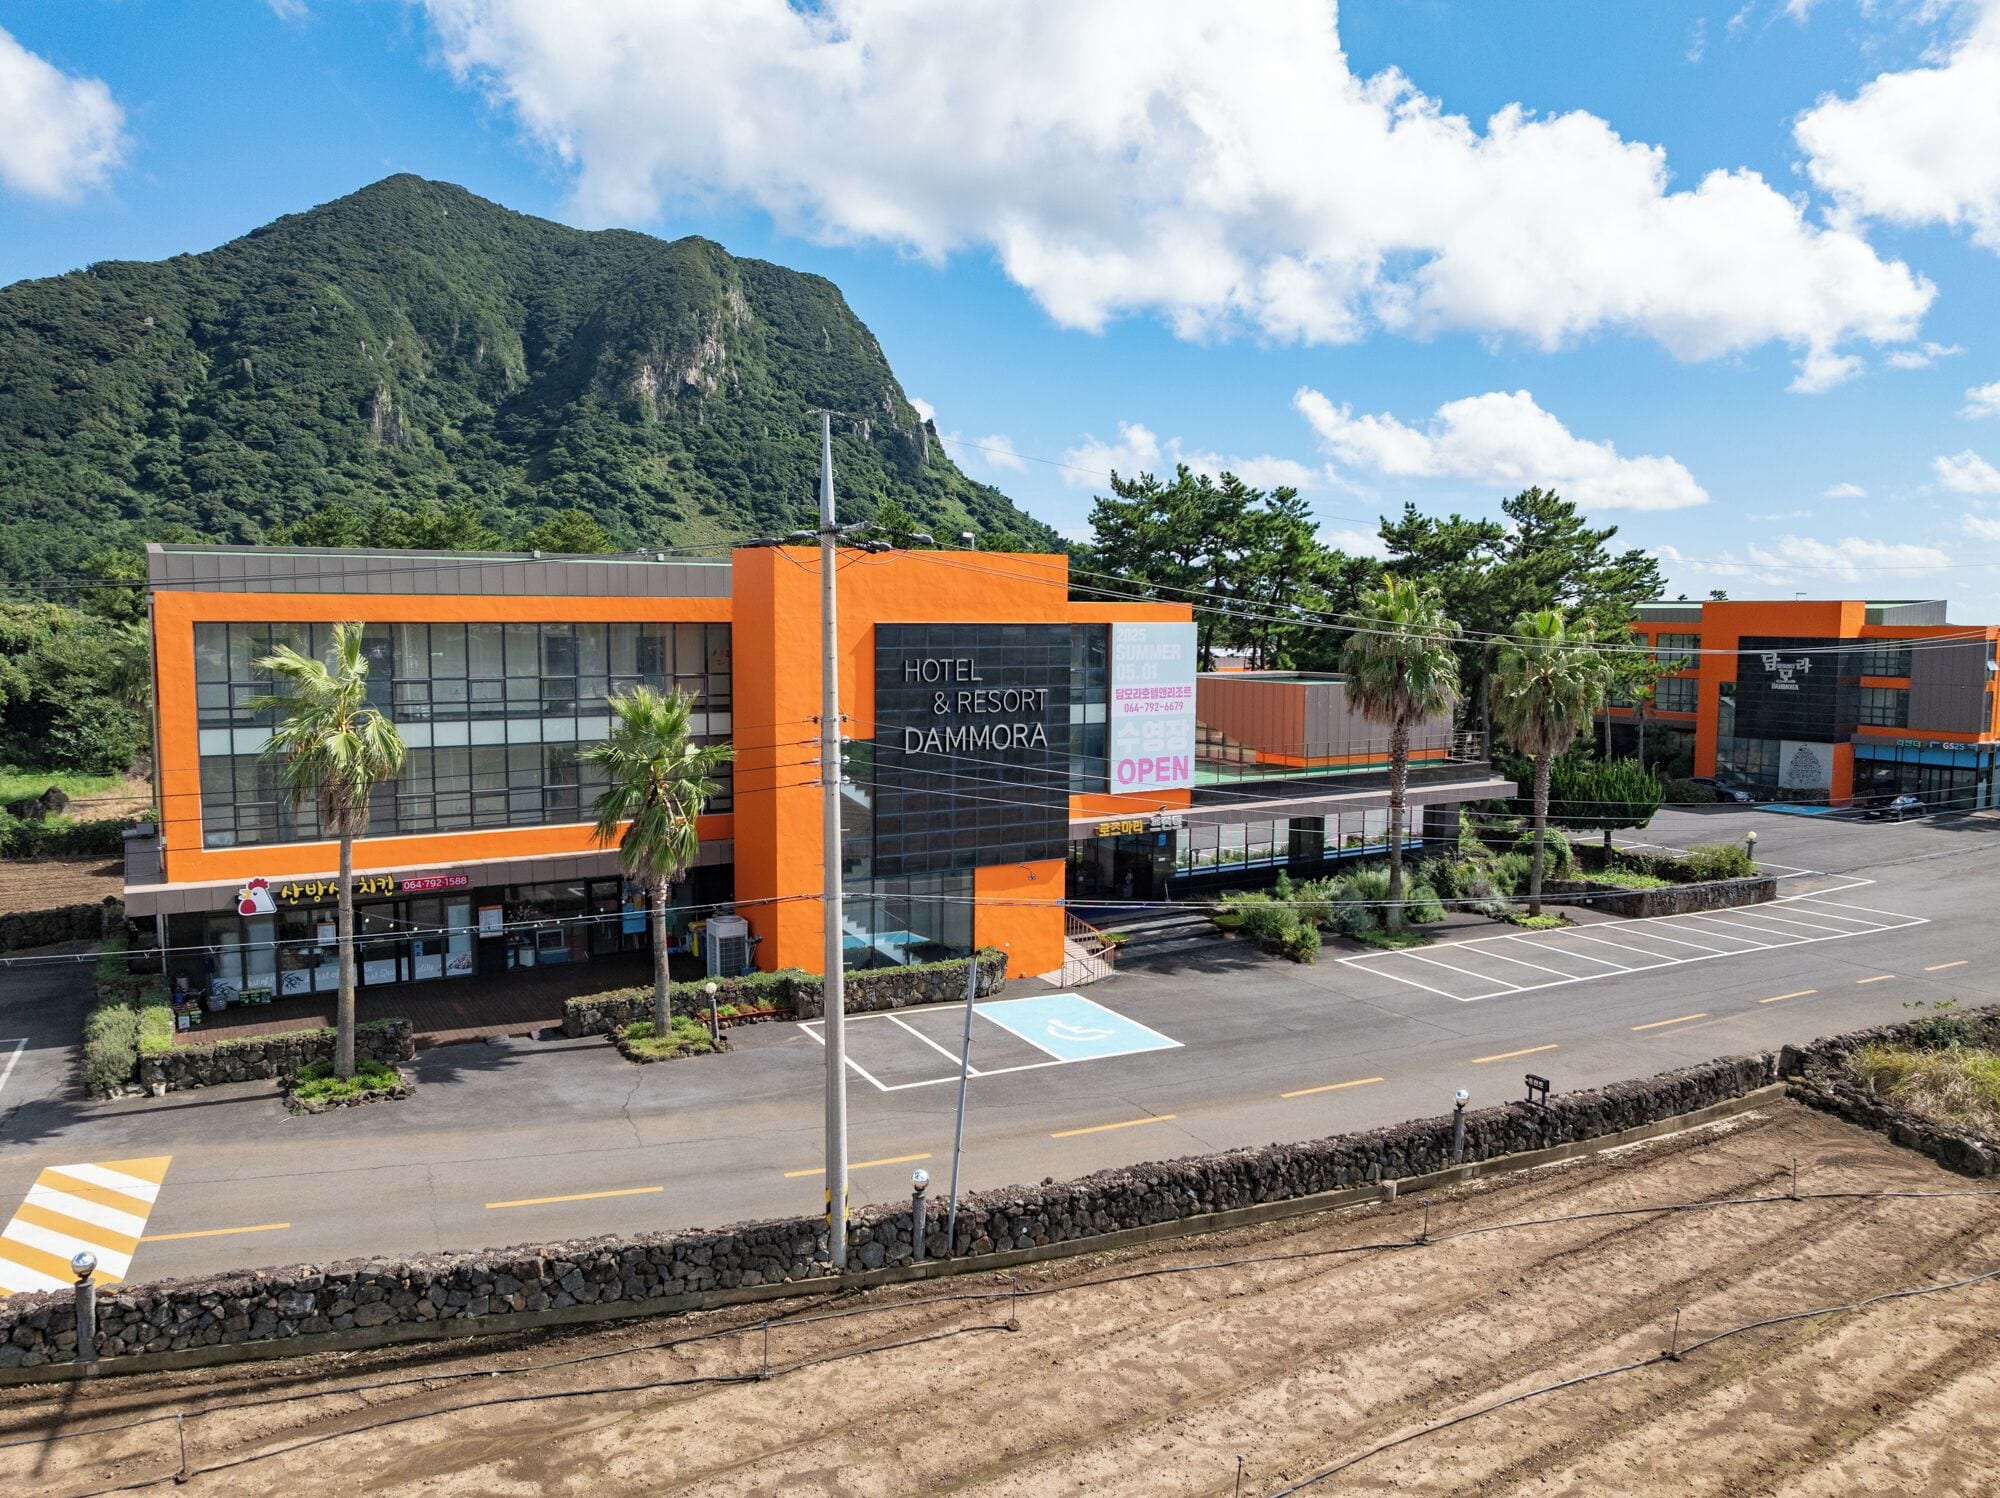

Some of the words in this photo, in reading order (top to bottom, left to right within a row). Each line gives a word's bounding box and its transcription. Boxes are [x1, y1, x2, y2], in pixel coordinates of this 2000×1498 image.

[1117, 629, 1146, 642] 2025
[1116, 644, 1181, 660] SUMMER
[904, 658, 983, 682] HOTEL
[933, 691, 951, 715] &
[958, 689, 1048, 713] RESORT
[1115, 686, 1192, 701] 담모라호텔앤리조트
[1124, 701, 1184, 713] 064-792-6679
[904, 722, 1048, 755] DAMMORA
[1117, 719, 1189, 754] 수영장
[1942, 742, 1965, 751] GS25
[1117, 755, 1189, 785] OPEN
[1098, 820, 1144, 837] 로즈마리
[359, 876, 394, 896] 치킨
